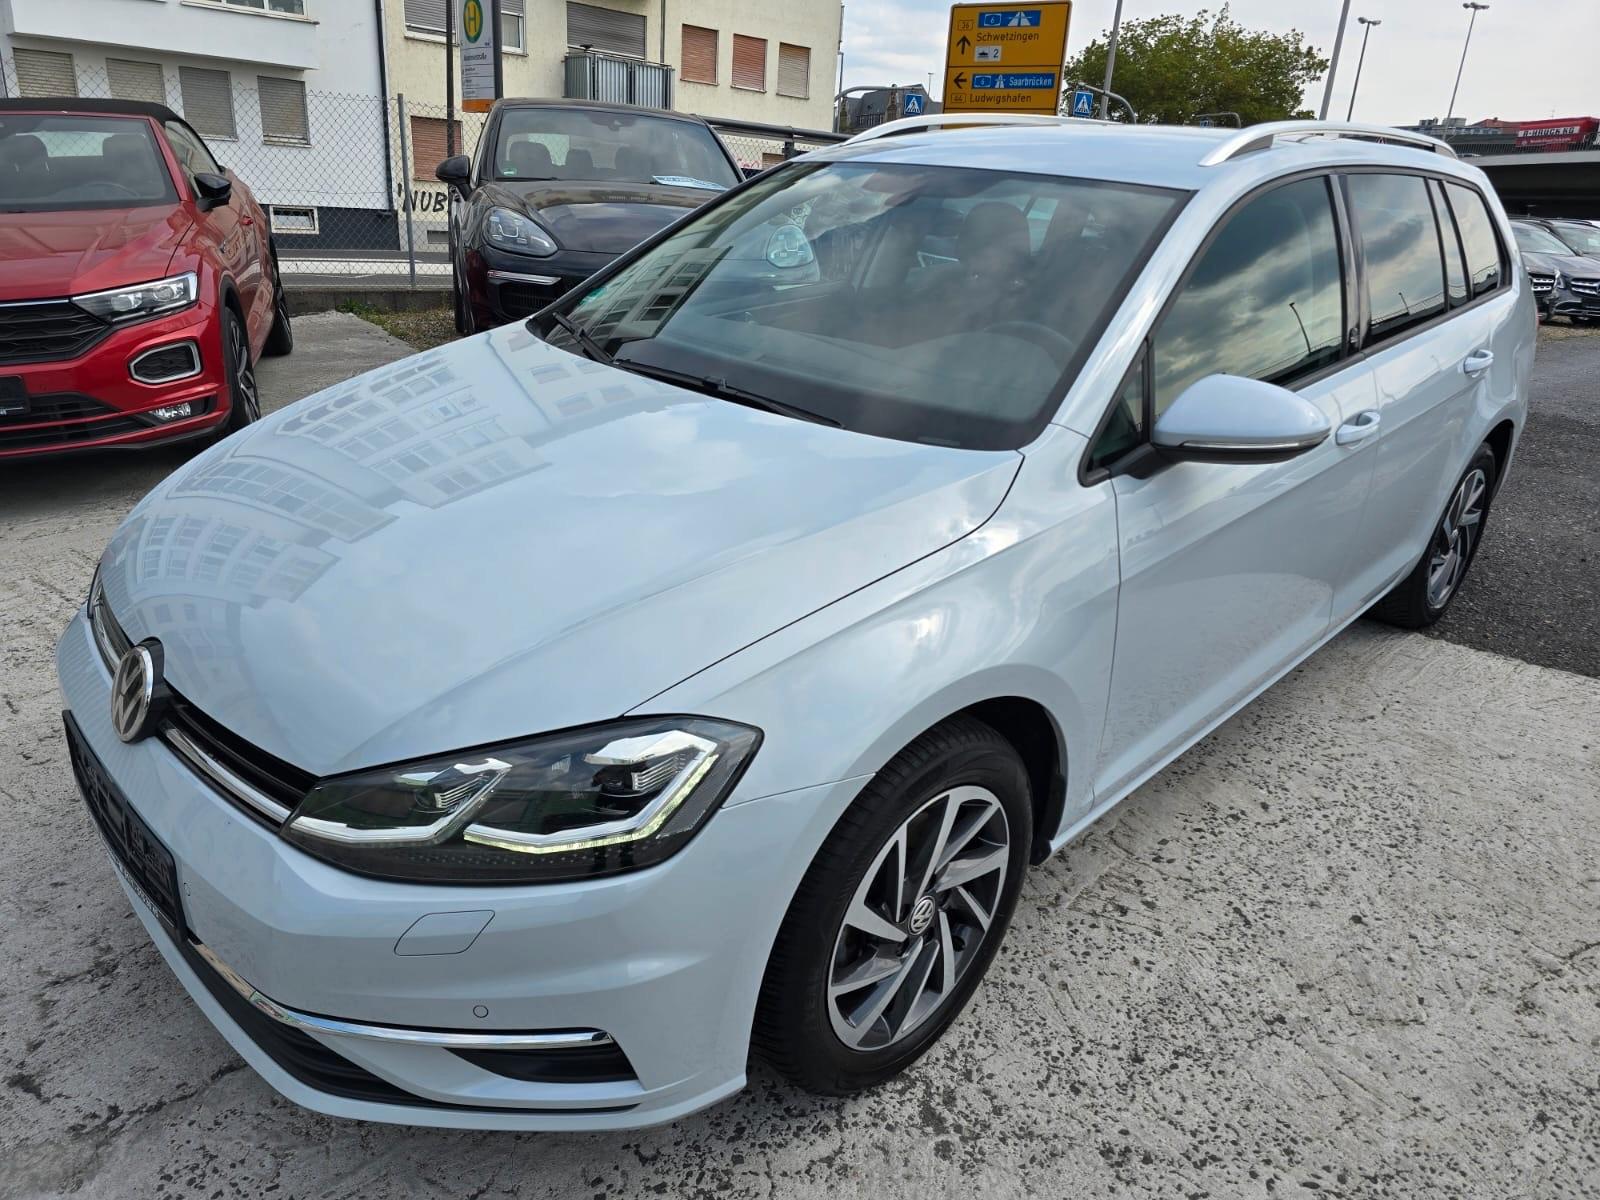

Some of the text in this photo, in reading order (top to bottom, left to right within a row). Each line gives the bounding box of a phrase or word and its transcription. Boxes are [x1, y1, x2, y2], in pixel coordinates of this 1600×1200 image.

[976, 31, 1040, 43] Schwetzingen
[993, 48, 999, 58] 2
[1009, 76, 1053, 87] Saarbrücken
[969, 93, 1032, 104] Ludwigshafen
